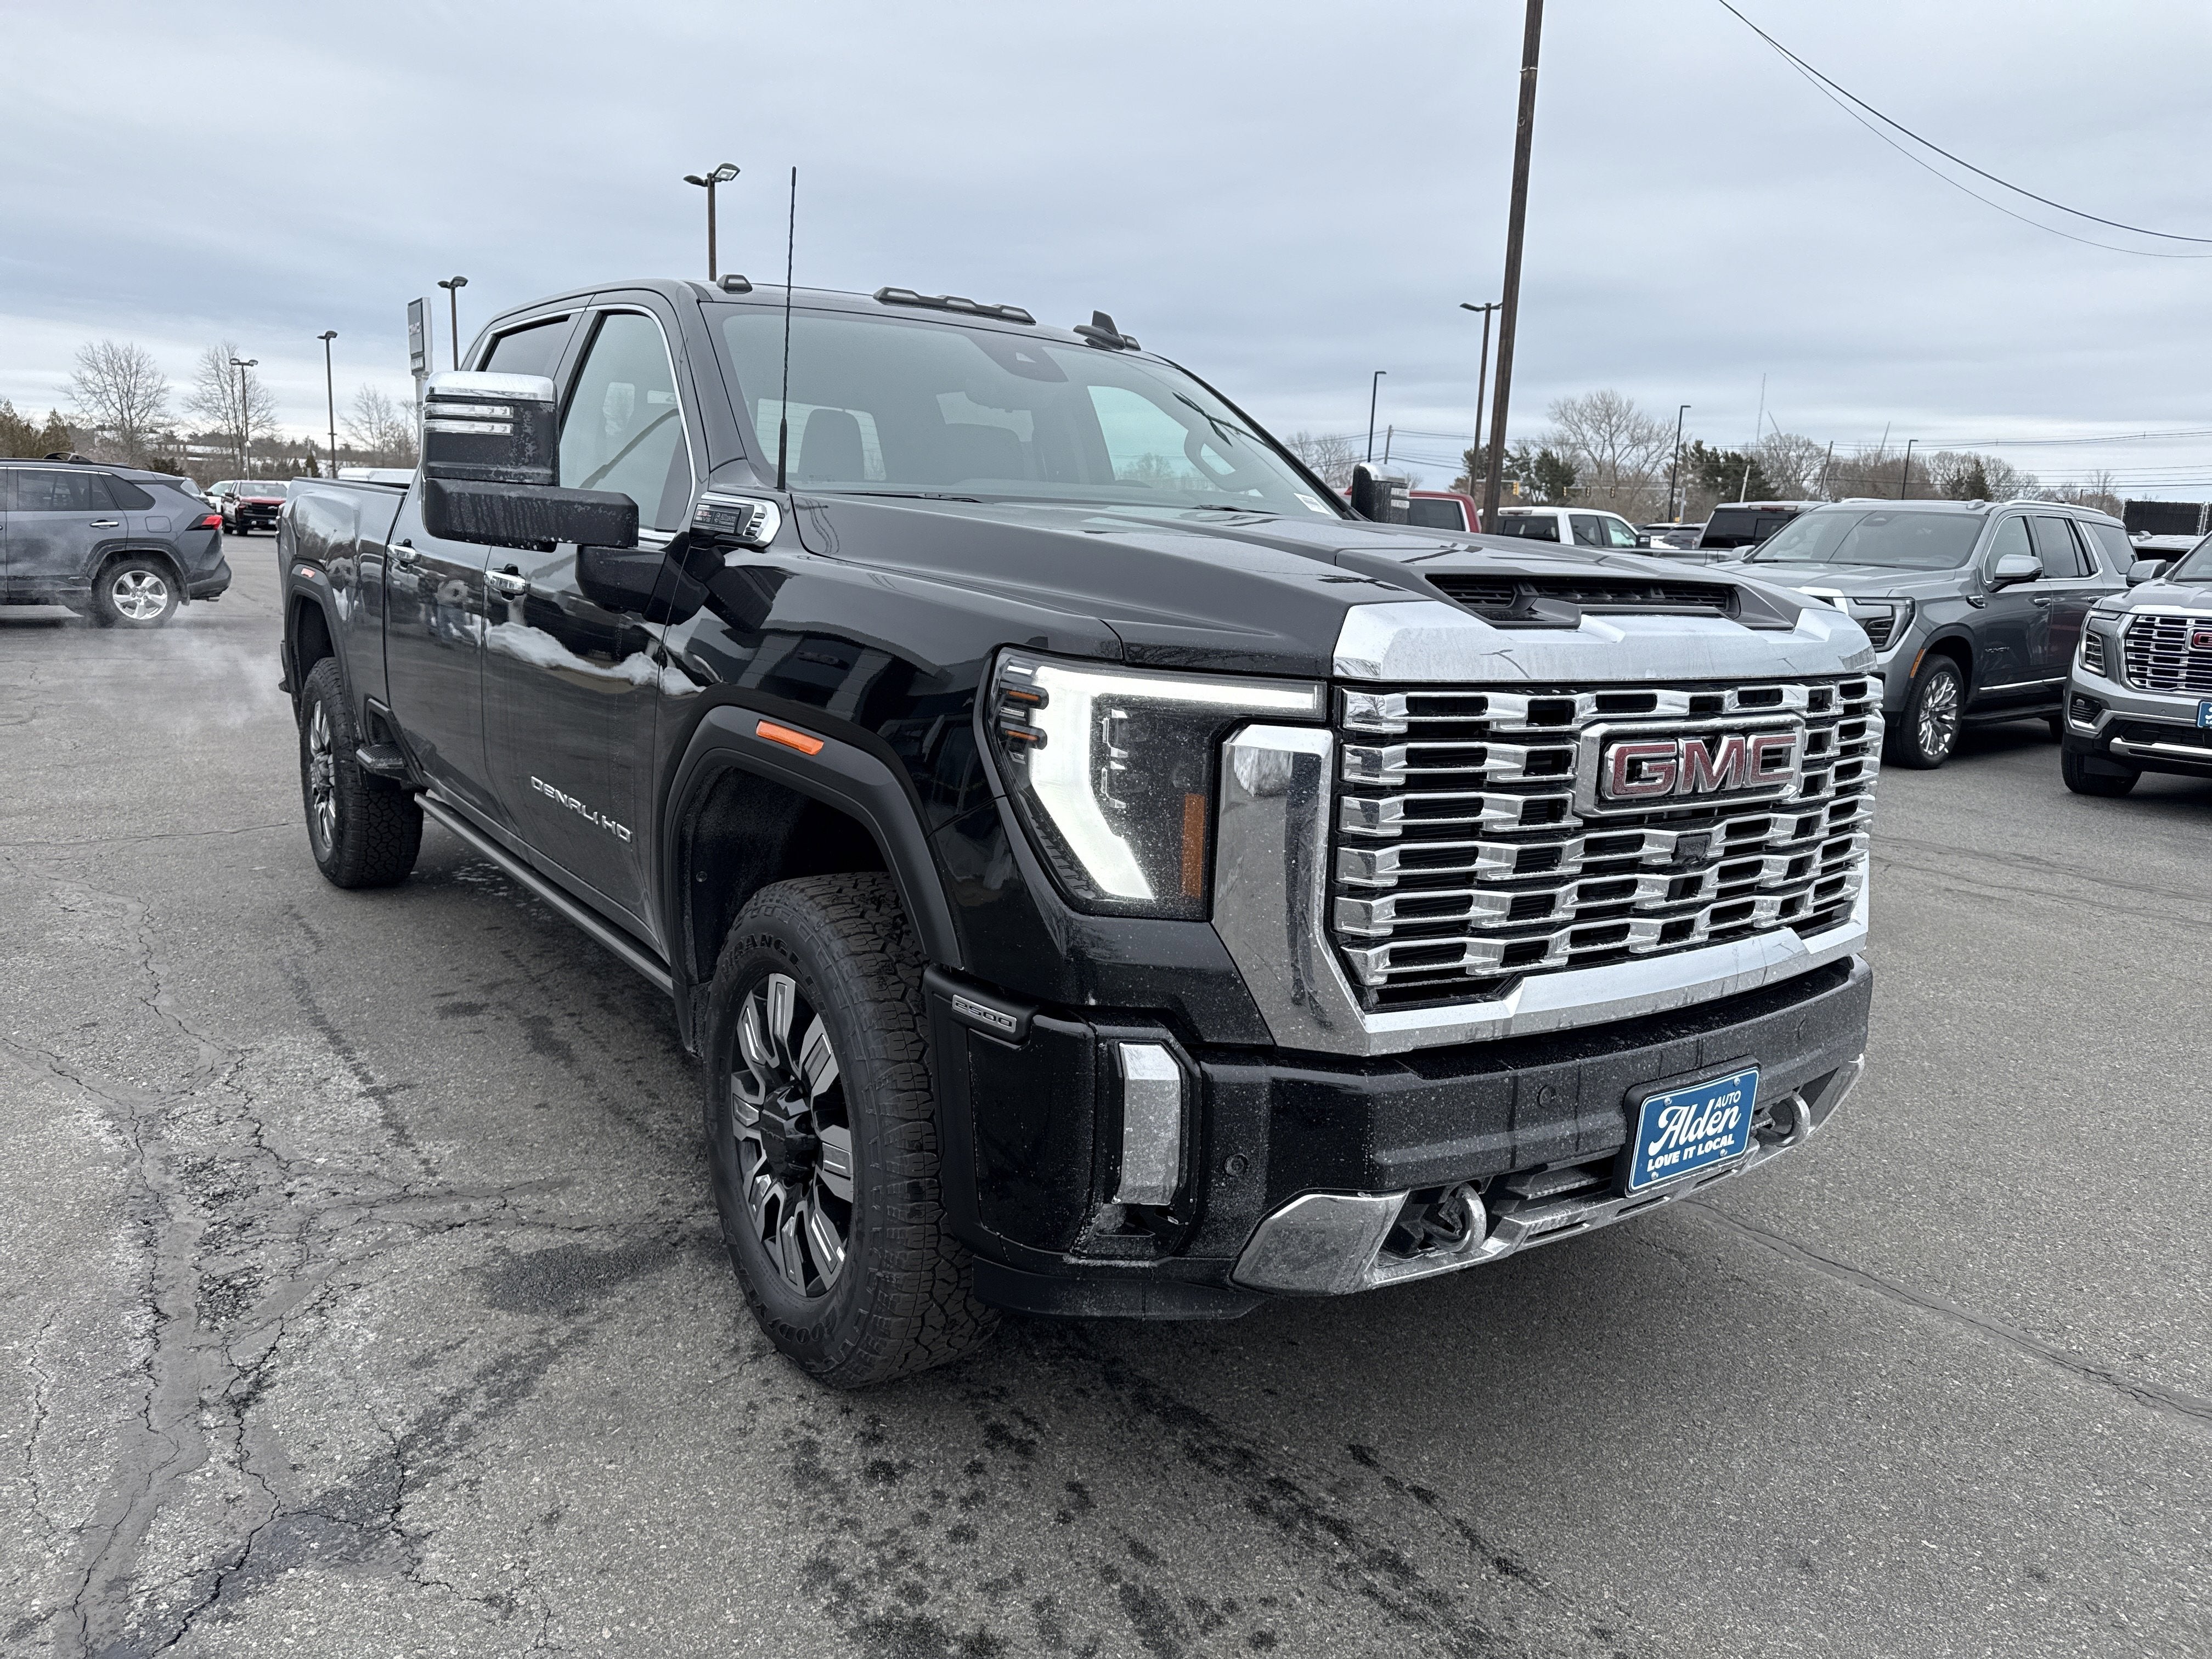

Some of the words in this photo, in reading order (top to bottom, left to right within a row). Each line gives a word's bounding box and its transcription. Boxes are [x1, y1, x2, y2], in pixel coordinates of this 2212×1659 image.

[1602, 732, 1797, 800] GMC
[531, 776, 599, 825] DENALI
[602, 815, 632, 843] HD
[955, 1000, 1012, 1027] 2500
[1714, 1090, 1741, 1110] AUTO
[1648, 1098, 1742, 1156] Alden
[1647, 1150, 1681, 1172] LOVE
[1683, 1146, 1696, 1160] IT
[1697, 1133, 1735, 1156] LOCAL
